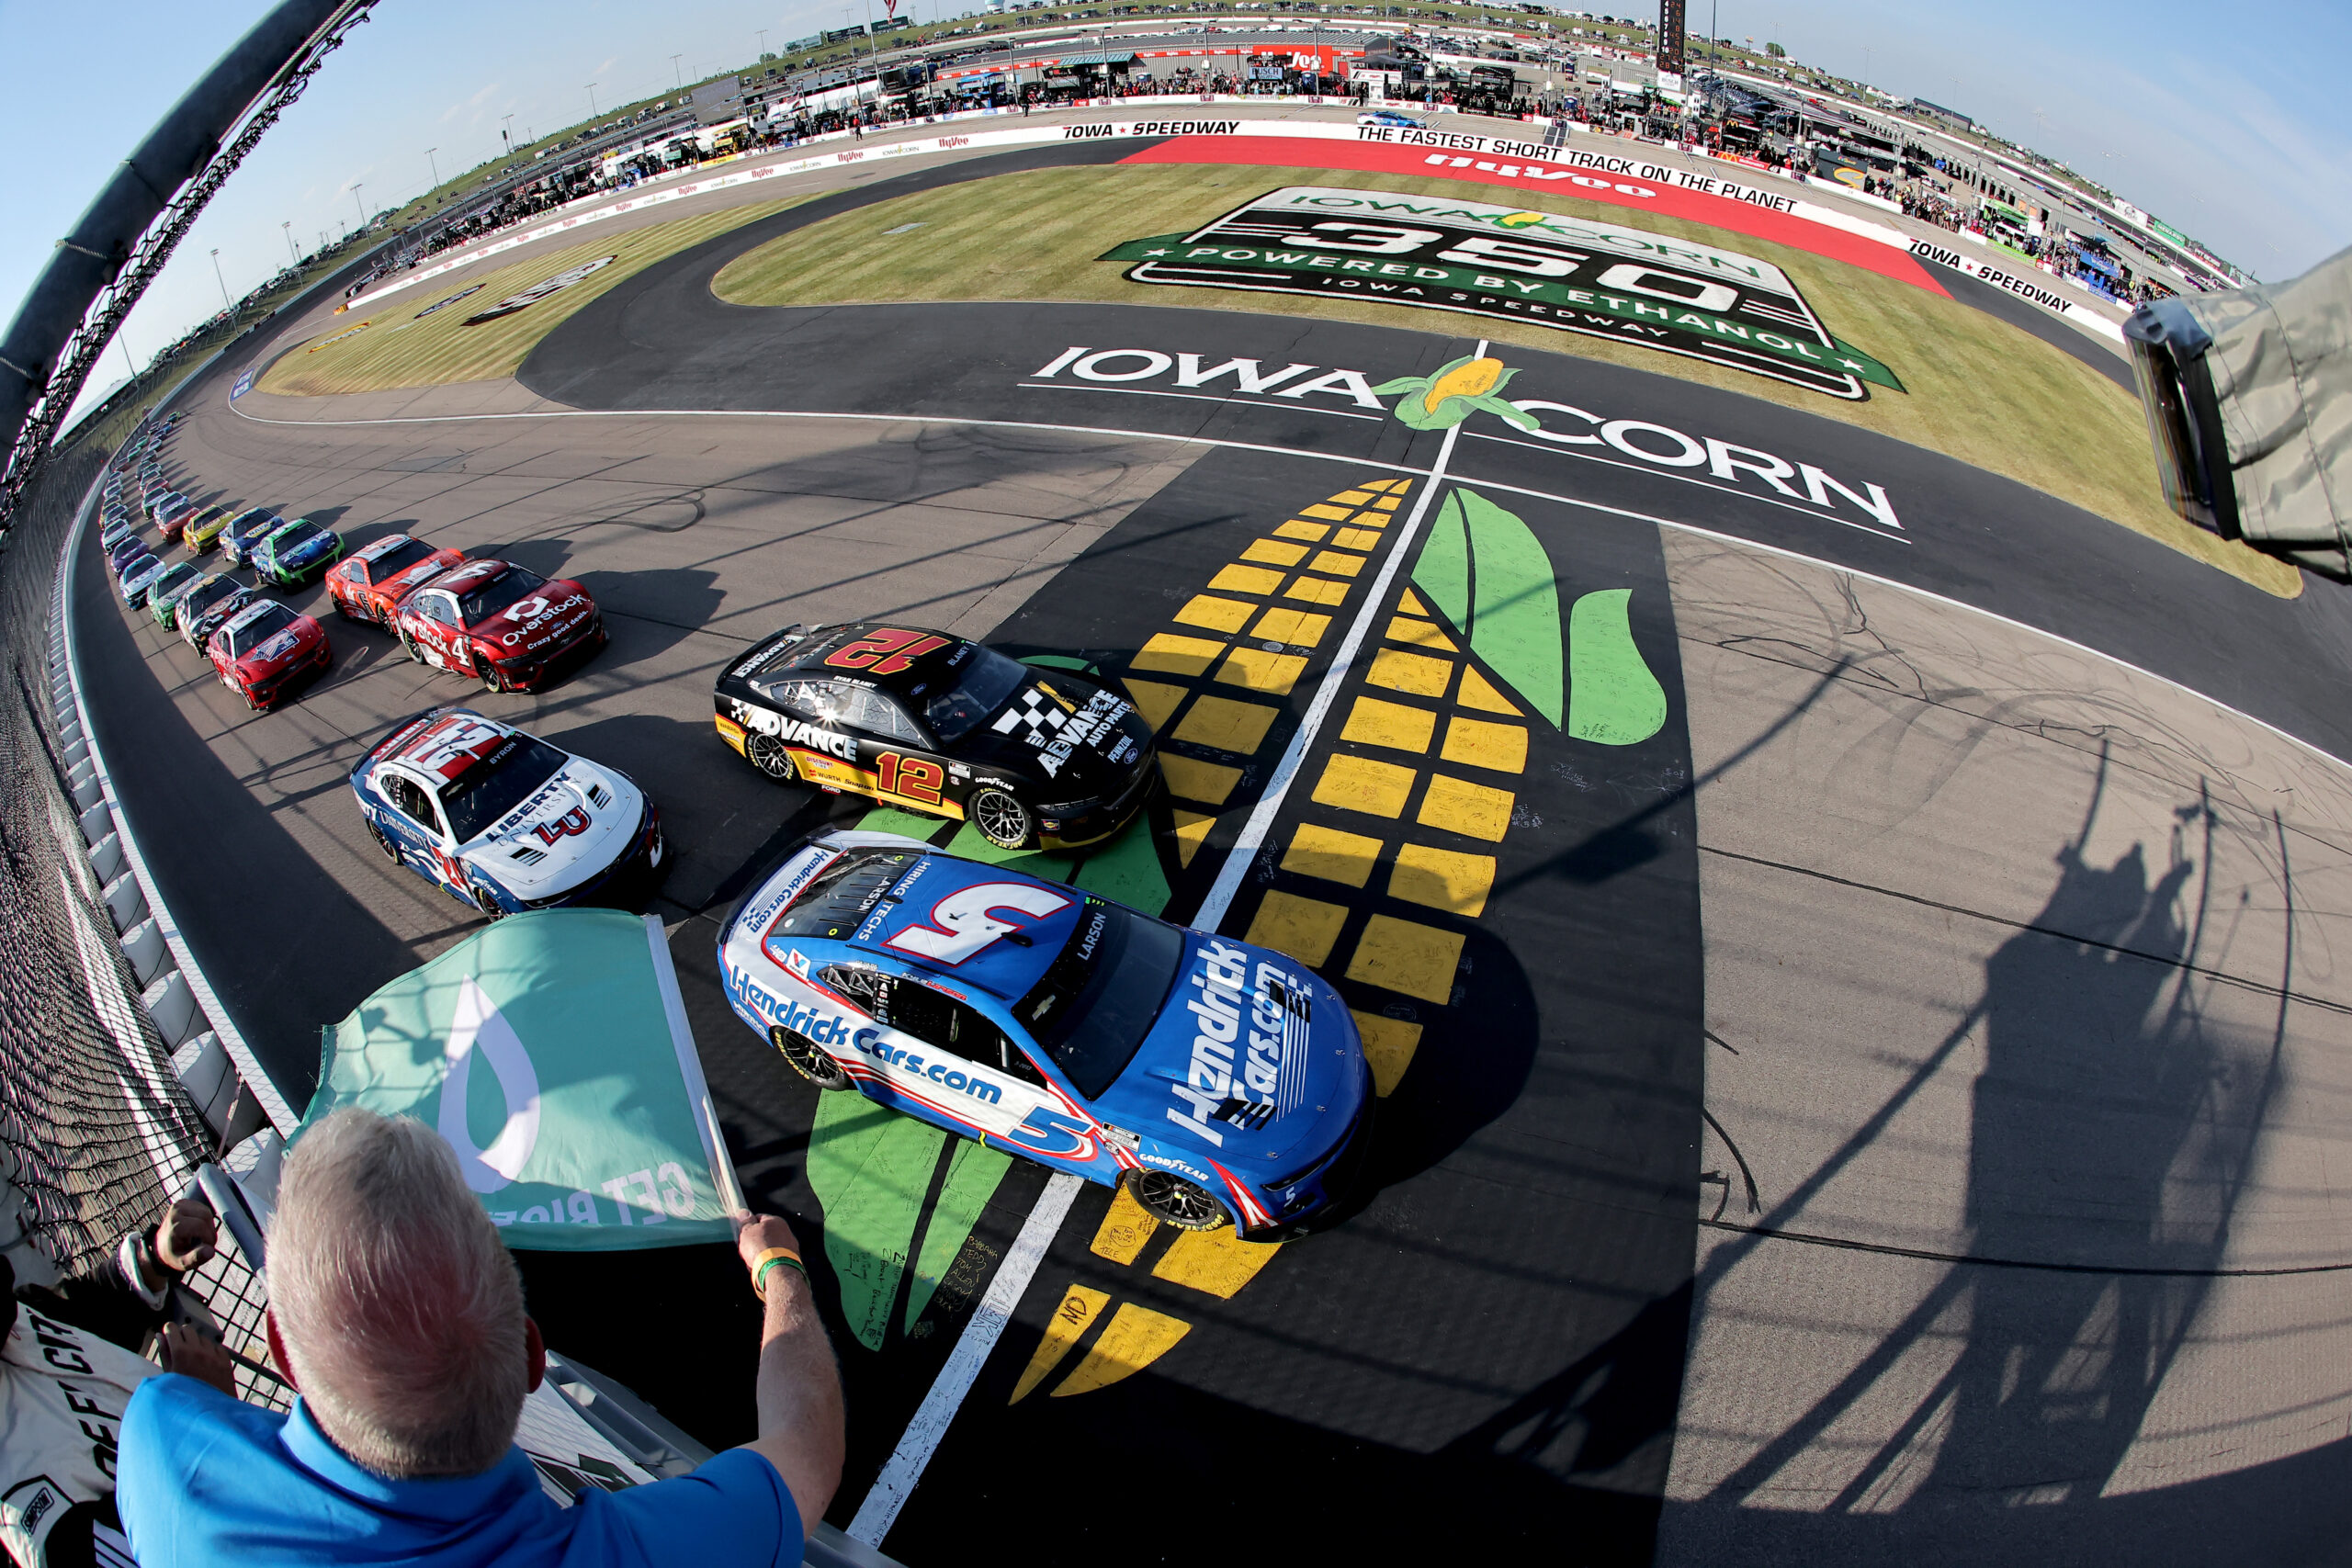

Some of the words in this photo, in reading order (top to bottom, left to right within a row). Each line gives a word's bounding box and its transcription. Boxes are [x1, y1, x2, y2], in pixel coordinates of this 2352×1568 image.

[1063, 124, 1113, 138] IOWA
[1133, 121, 1239, 136] SPEEDWAY
[1358, 127, 1394, 141] THE
[1401, 130, 1487, 151] FASTEST
[1492, 140, 1562, 161] SHORT
[1569, 151, 1634, 175] TRACK
[1641, 165, 1671, 182] ON
[1679, 173, 1717, 193] THE
[1722, 183, 1798, 213] PLANET
[1290, 196, 1484, 222] IOWA
[1558, 224, 1761, 278] CORN
[1281, 222, 1738, 312] 350
[1910, 238, 1961, 268] IOWA
[1977, 266, 2073, 312] SPEEDWAY
[1185, 248, 1450, 279] POWERED
[1473, 275, 1544, 294] BY
[1566, 289, 1821, 359] ETHANOL
[1323, 277, 1424, 295] IOWA
[1450, 293, 1669, 337] SPEEDWAY
[1030, 347, 1387, 412] IOWA
[1499, 399, 1904, 530] CORN
[248, 522, 272, 537] NAPA
[503, 593, 587, 646] Overstock
[552, 624, 571, 637] good
[570, 610, 588, 626] deals.
[452, 637, 471, 669] 4
[736, 639, 784, 678] ADVANCE
[824, 627, 953, 675] 12
[947, 646, 969, 667] BLANEY
[853, 679, 878, 688] BLANEY
[747, 706, 858, 761] ADVANCE
[1037, 689, 1120, 779] ADVANCE
[1086, 721, 1111, 748] AUTO
[1106, 701, 1132, 725] PARTS
[489, 741, 517, 764] BYRON
[1107, 735, 1134, 763] PENNZOIL
[821, 784, 841, 794] FORD
[876, 750, 944, 806] 12
[975, 777, 1014, 792] GOODYEAR
[379, 810, 428, 849] UNIVERSITY
[485, 772, 571, 842] LIBERTY
[498, 778, 581, 847] UNIVERSITY
[529, 805, 592, 847] LU
[893, 861, 931, 897] HIRING
[858, 900, 895, 942] TECHS
[880, 880, 1077, 968] 5
[1077, 912, 1106, 960] LARSON
[1166, 941, 1248, 1148] Hendrick
[1232, 962, 1286, 1106] Cars.com
[1007, 1102, 1097, 1160] 5
[1139, 1153, 1209, 1181] GOODYEAR
[1166, 1213, 1225, 1232] GOODYEAR
[24, 1494, 51, 1529] SIMPSON
